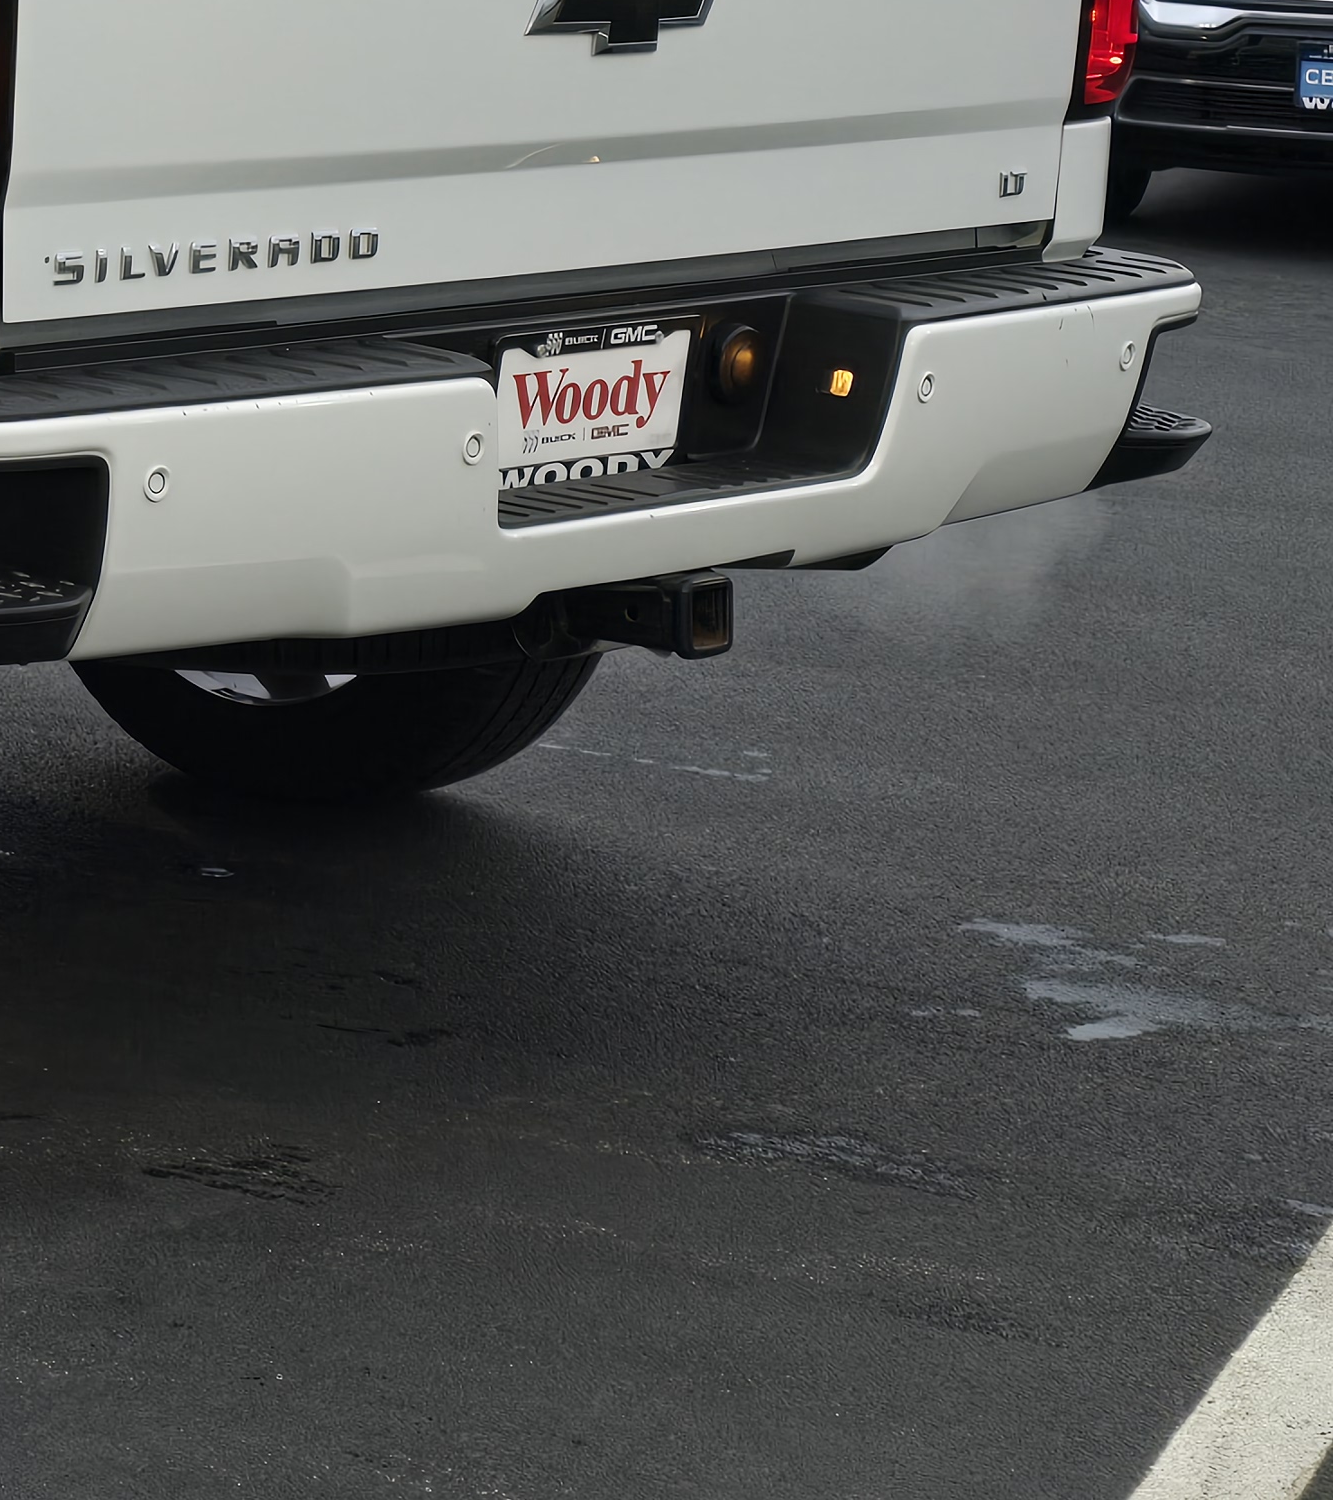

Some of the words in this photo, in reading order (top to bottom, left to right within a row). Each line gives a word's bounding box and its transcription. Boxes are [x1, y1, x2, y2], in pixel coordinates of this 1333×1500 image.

[999, 166, 1027, 198] LT
[53, 227, 380, 286] SILVERADO
[610, 324, 659, 345] GMC
[512, 359, 672, 429] Woody
